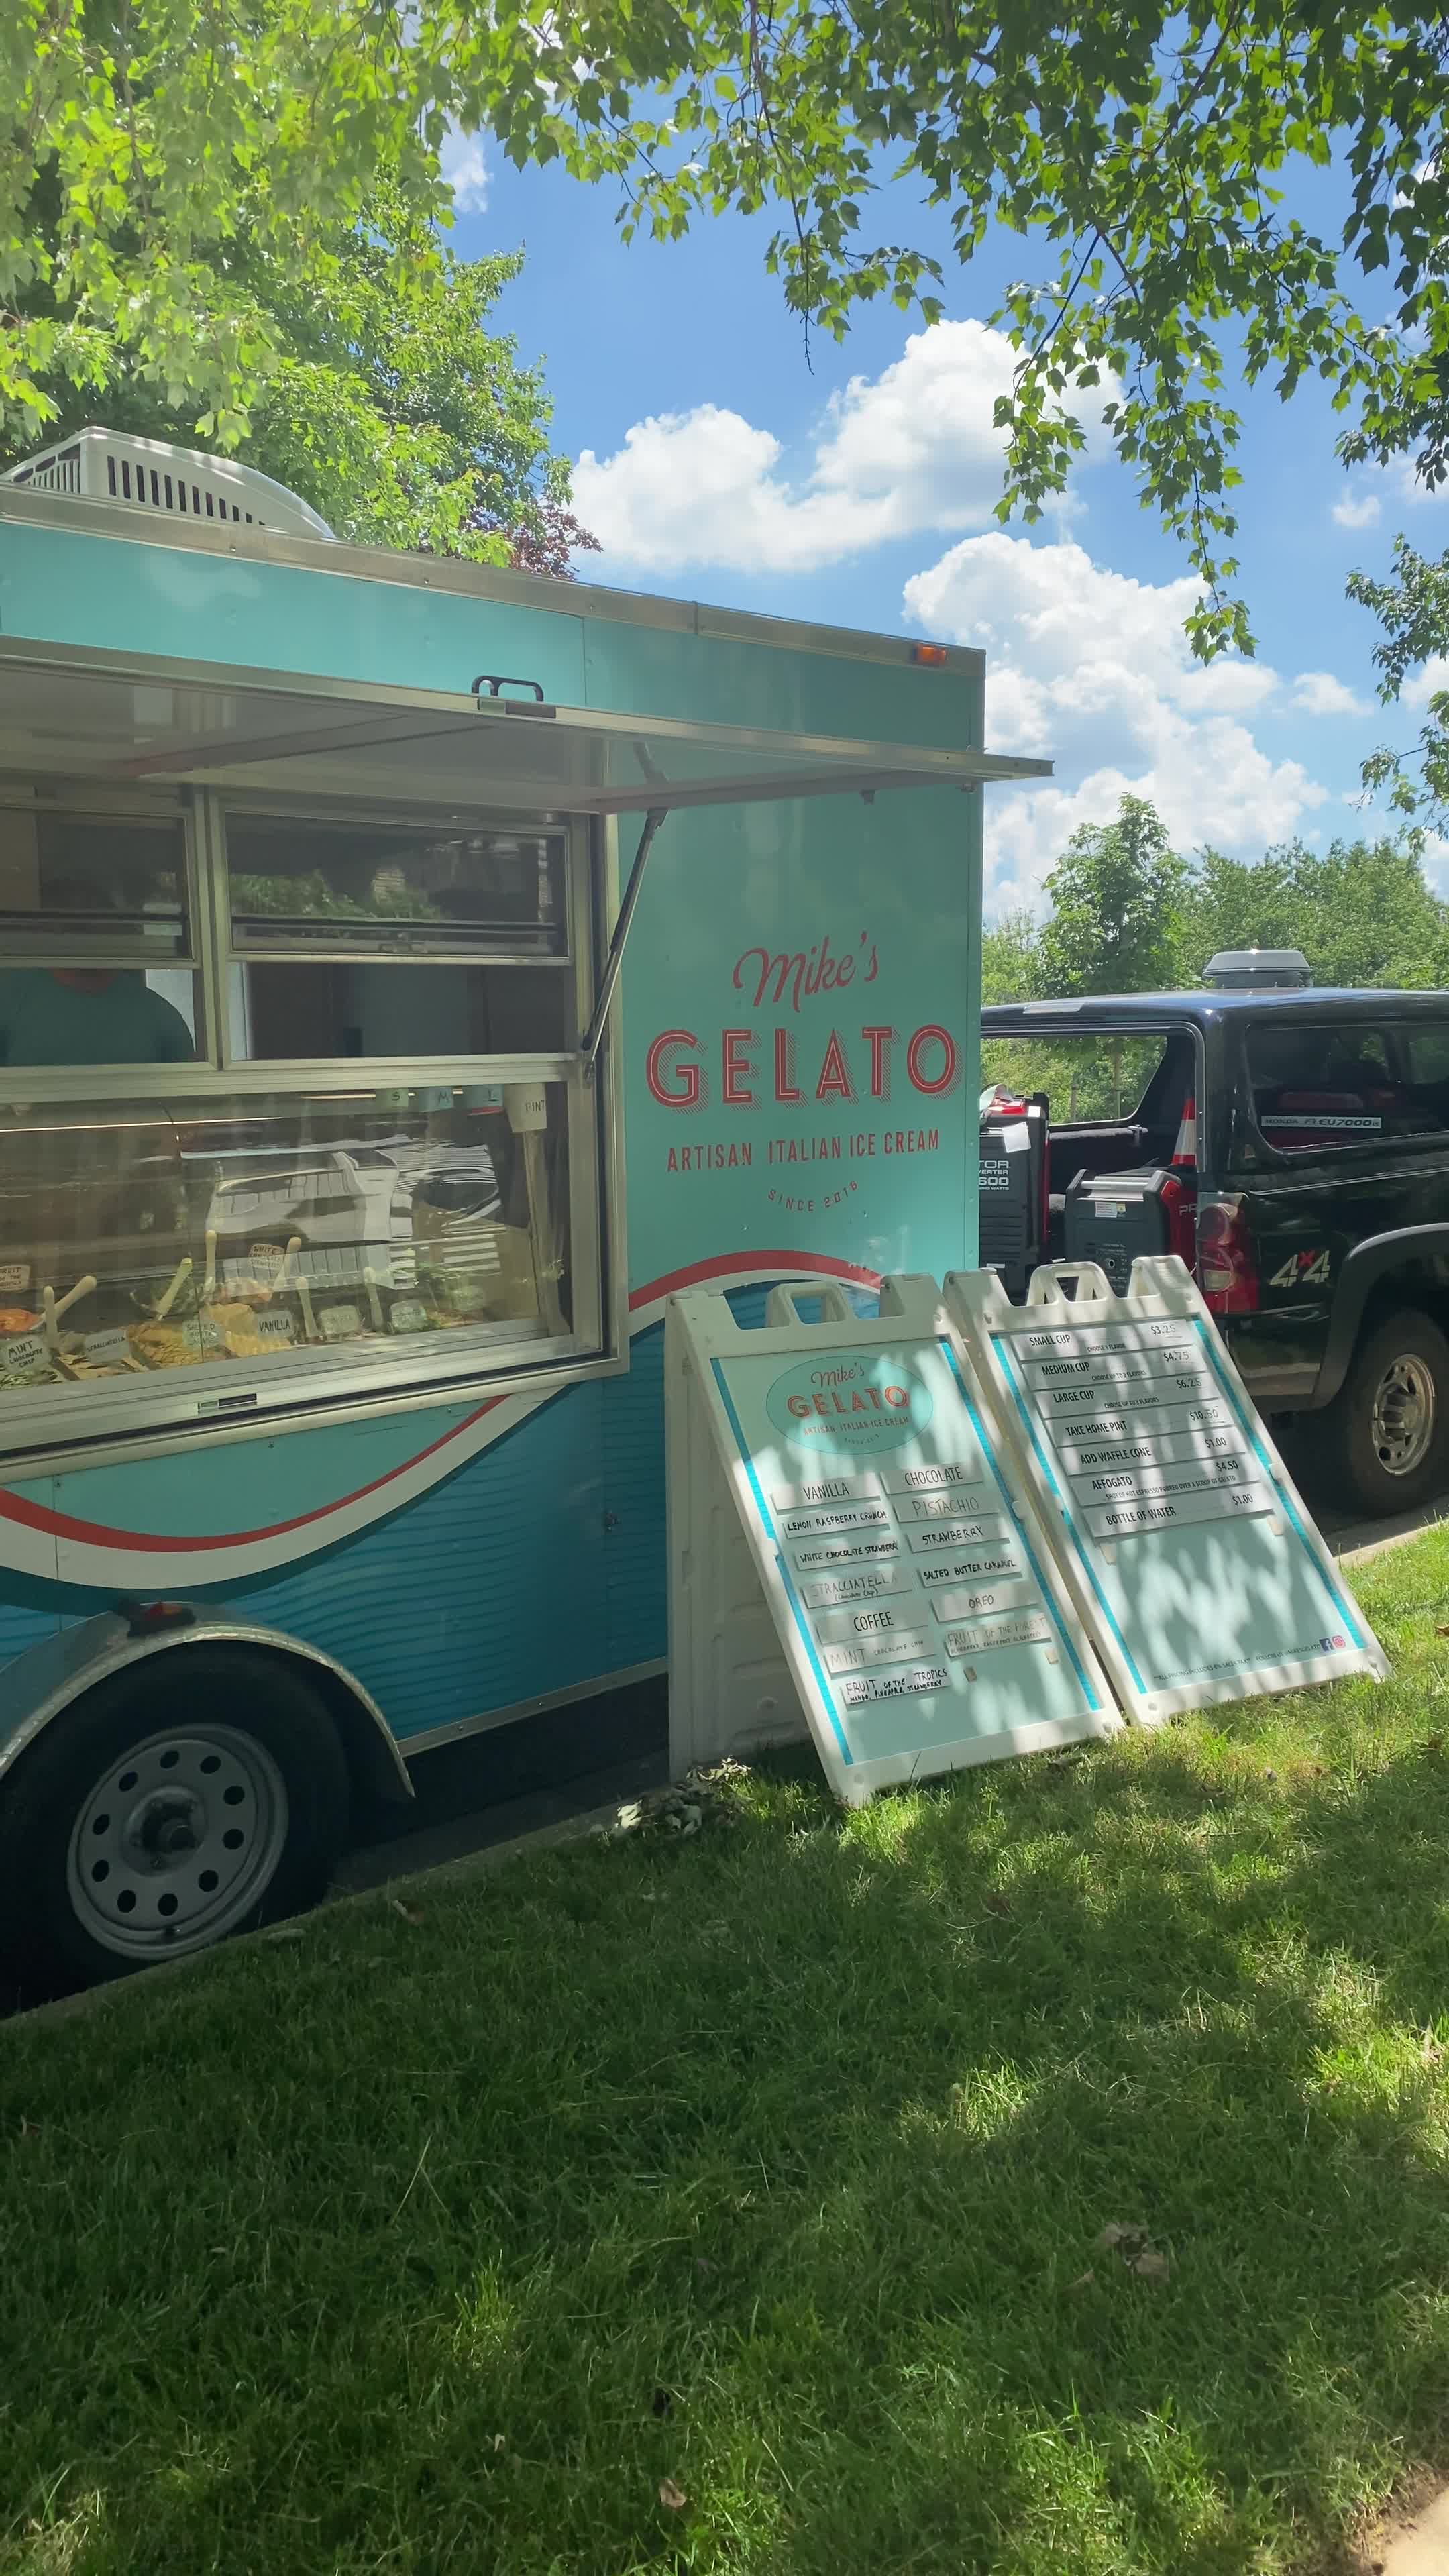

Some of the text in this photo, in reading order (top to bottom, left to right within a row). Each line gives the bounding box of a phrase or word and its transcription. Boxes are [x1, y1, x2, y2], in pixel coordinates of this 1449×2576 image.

[733, 931, 879, 1013] Mike's
[645, 1024, 962, 1115] GELATO
[525, 1099, 545, 1112] PINT
[667, 1128, 939, 1171] ARTISAN ITALIAN ICE CREAM
[768, 1189, 814, 1212] SINCE
[259, 1319, 290, 1332] VANILLA
[1150, 1325, 1176, 1336] $3.25
[1029, 1334, 1071, 1346] SMALL CUP
[9, 1340, 33, 1358] MINT
[1163, 1351, 1190, 1362] $4.75
[810, 1362, 865, 1388] Mike's
[1042, 1362, 1090, 1375] MEDIUM CUP
[1176, 1379, 1202, 1389] $6.25
[787, 1386, 910, 1417] GELATO
[1053, 1390, 1095, 1403] LARGE CUP
[840, 1420, 870, 1432] ITALIAN
[871, 1419, 883, 1428] ICE
[885, 1416, 909, 1427] CREAM
[1065, 1421, 1128, 1436] TAKE HOME PINT
[1205, 1437, 1227, 1449] $1.00
[1080, 1447, 1152, 1464] ADD WAFFLE CONE
[1216, 1460, 1238, 1472] $4.50
[905, 1466, 963, 1486] CHOCOLATE
[1092, 1476, 1132, 1490] AFFOGATO
[803, 1482, 850, 1500] VANILLA
[1136, 1487, 1160, 1495] ESPRESSO
[1160, 1484, 1179, 1492] POURED
[1218, 1475, 1236, 1483] GELATO
[912, 1497, 979, 1518] PISTACHIO
[1232, 1494, 1253, 1505] $1.00
[787, 1510, 886, 1531] LEMON RASPBERRY CRUNCH
[1106, 1507, 1176, 1525] BOTTLE OF WATER
[922, 1525, 983, 1545] STRAWBERRY
[800, 1552, 823, 1563] WHITE
[826, 1547, 863, 1559] CHOCOLATE
[923, 1568, 949, 1580] SALTED
[954, 1564, 982, 1576] BUTTER
[968, 1595, 994, 1608] OREO
[853, 1612, 894, 1631] COFFEE
[948, 1630, 977, 1646] FRUIT
[998, 1625, 1011, 1635] THE
[830, 1647, 866, 1666] MINT
[873, 1644, 907, 1656] CHOCOLATE
[845, 1679, 877, 1695] FRUIT
[892, 1678, 905, 1686] THE
[913, 1668, 947, 1682] TROPICS
